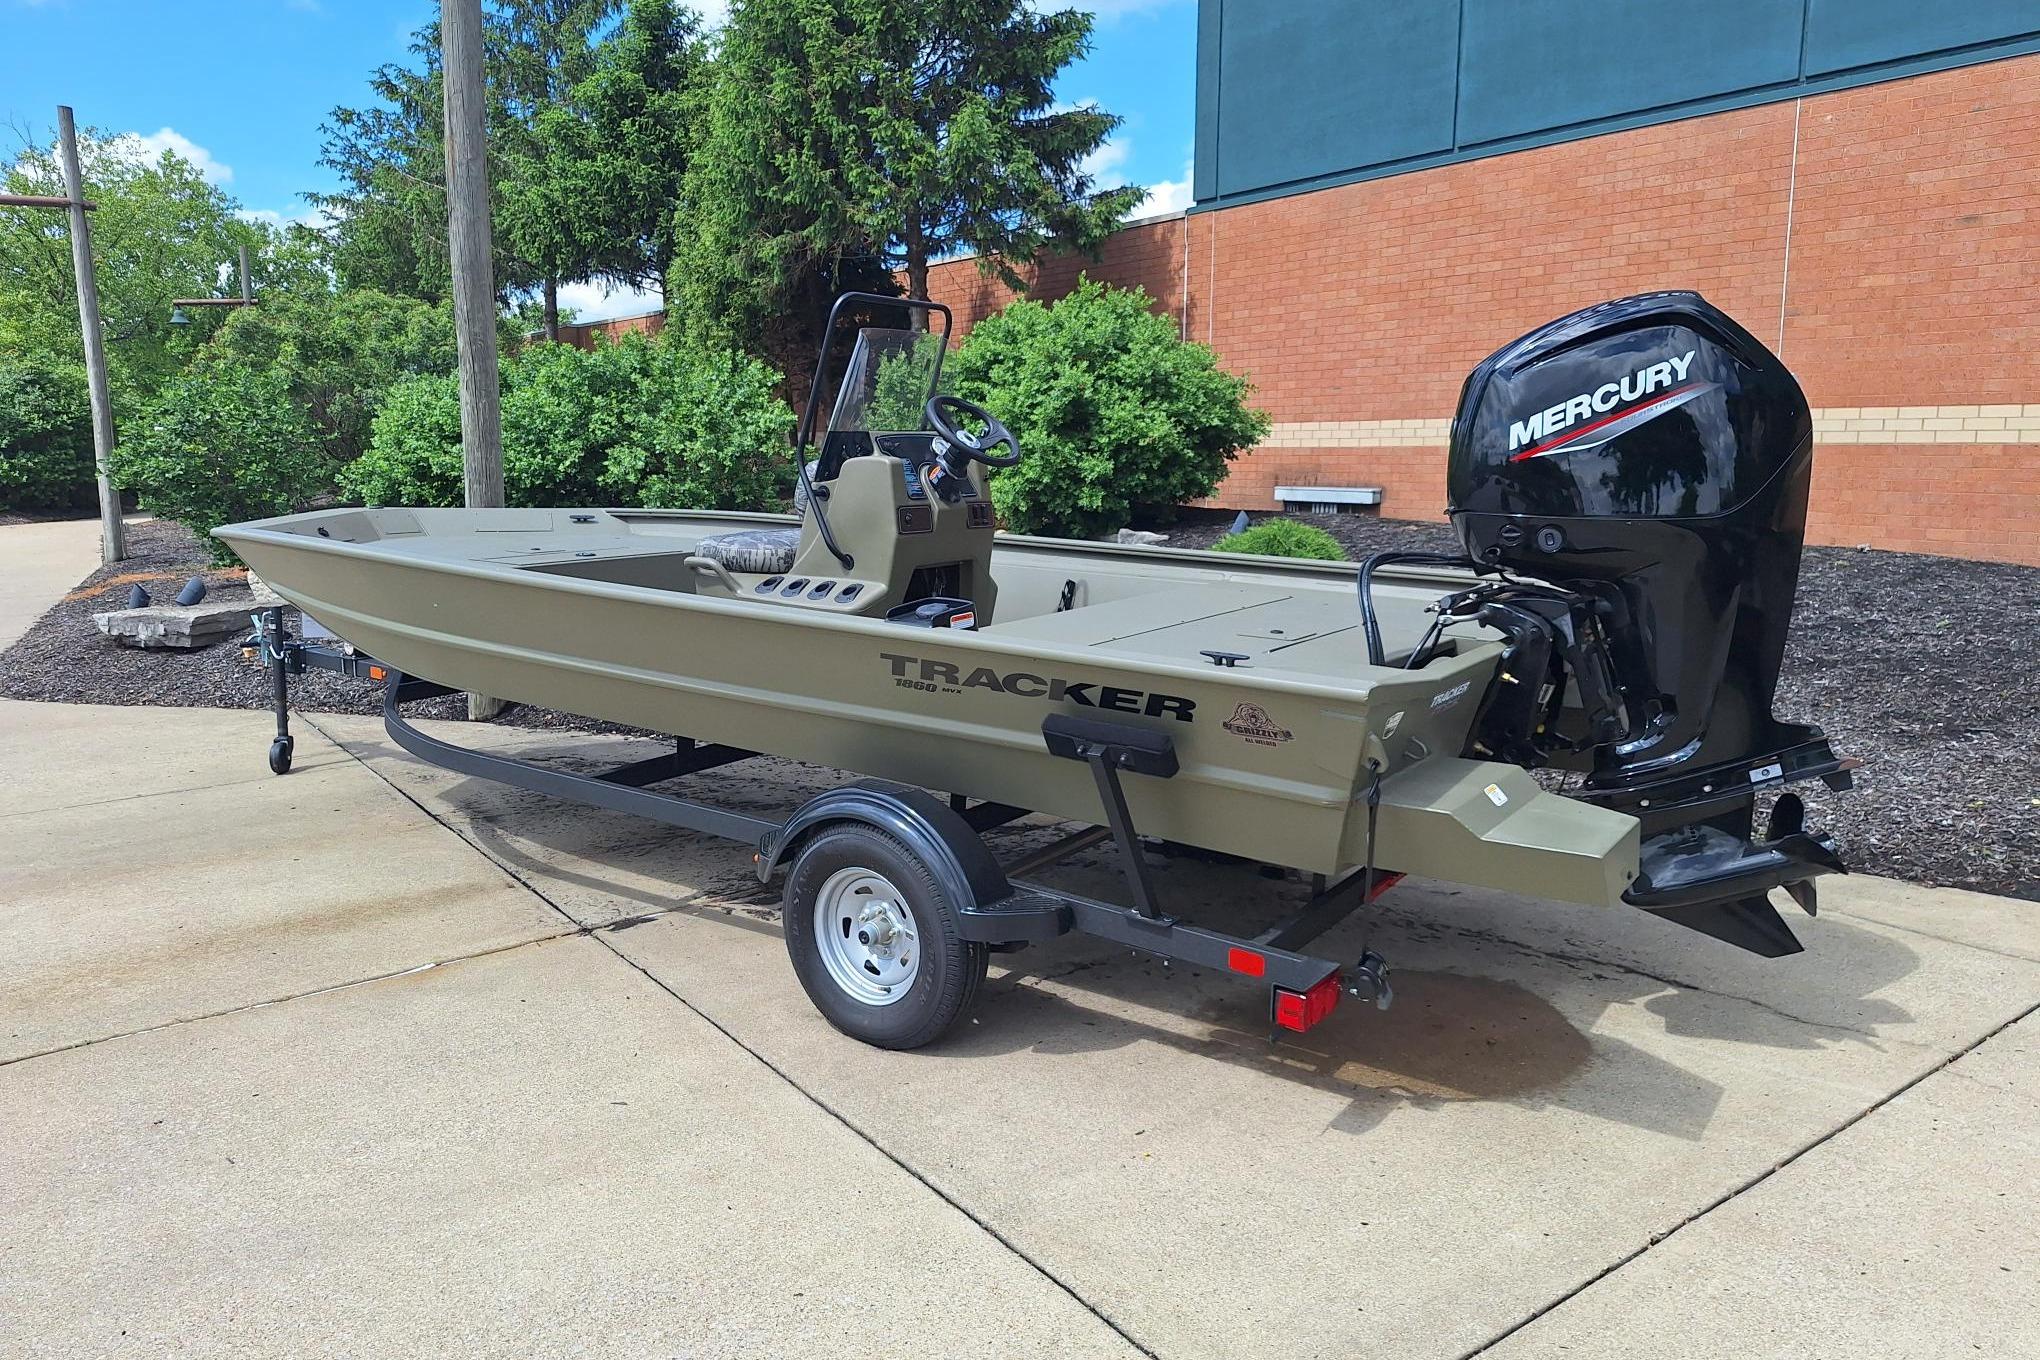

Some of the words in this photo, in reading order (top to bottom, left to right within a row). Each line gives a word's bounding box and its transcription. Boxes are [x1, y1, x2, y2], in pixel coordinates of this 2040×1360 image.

[1508, 350, 1696, 451] MERCURY
[879, 652, 1198, 723] TRACKER
[894, 678, 938, 693] 1860
[1430, 681, 1471, 708] TRACKER
[1236, 726, 1278, 738] GRIZZLY
